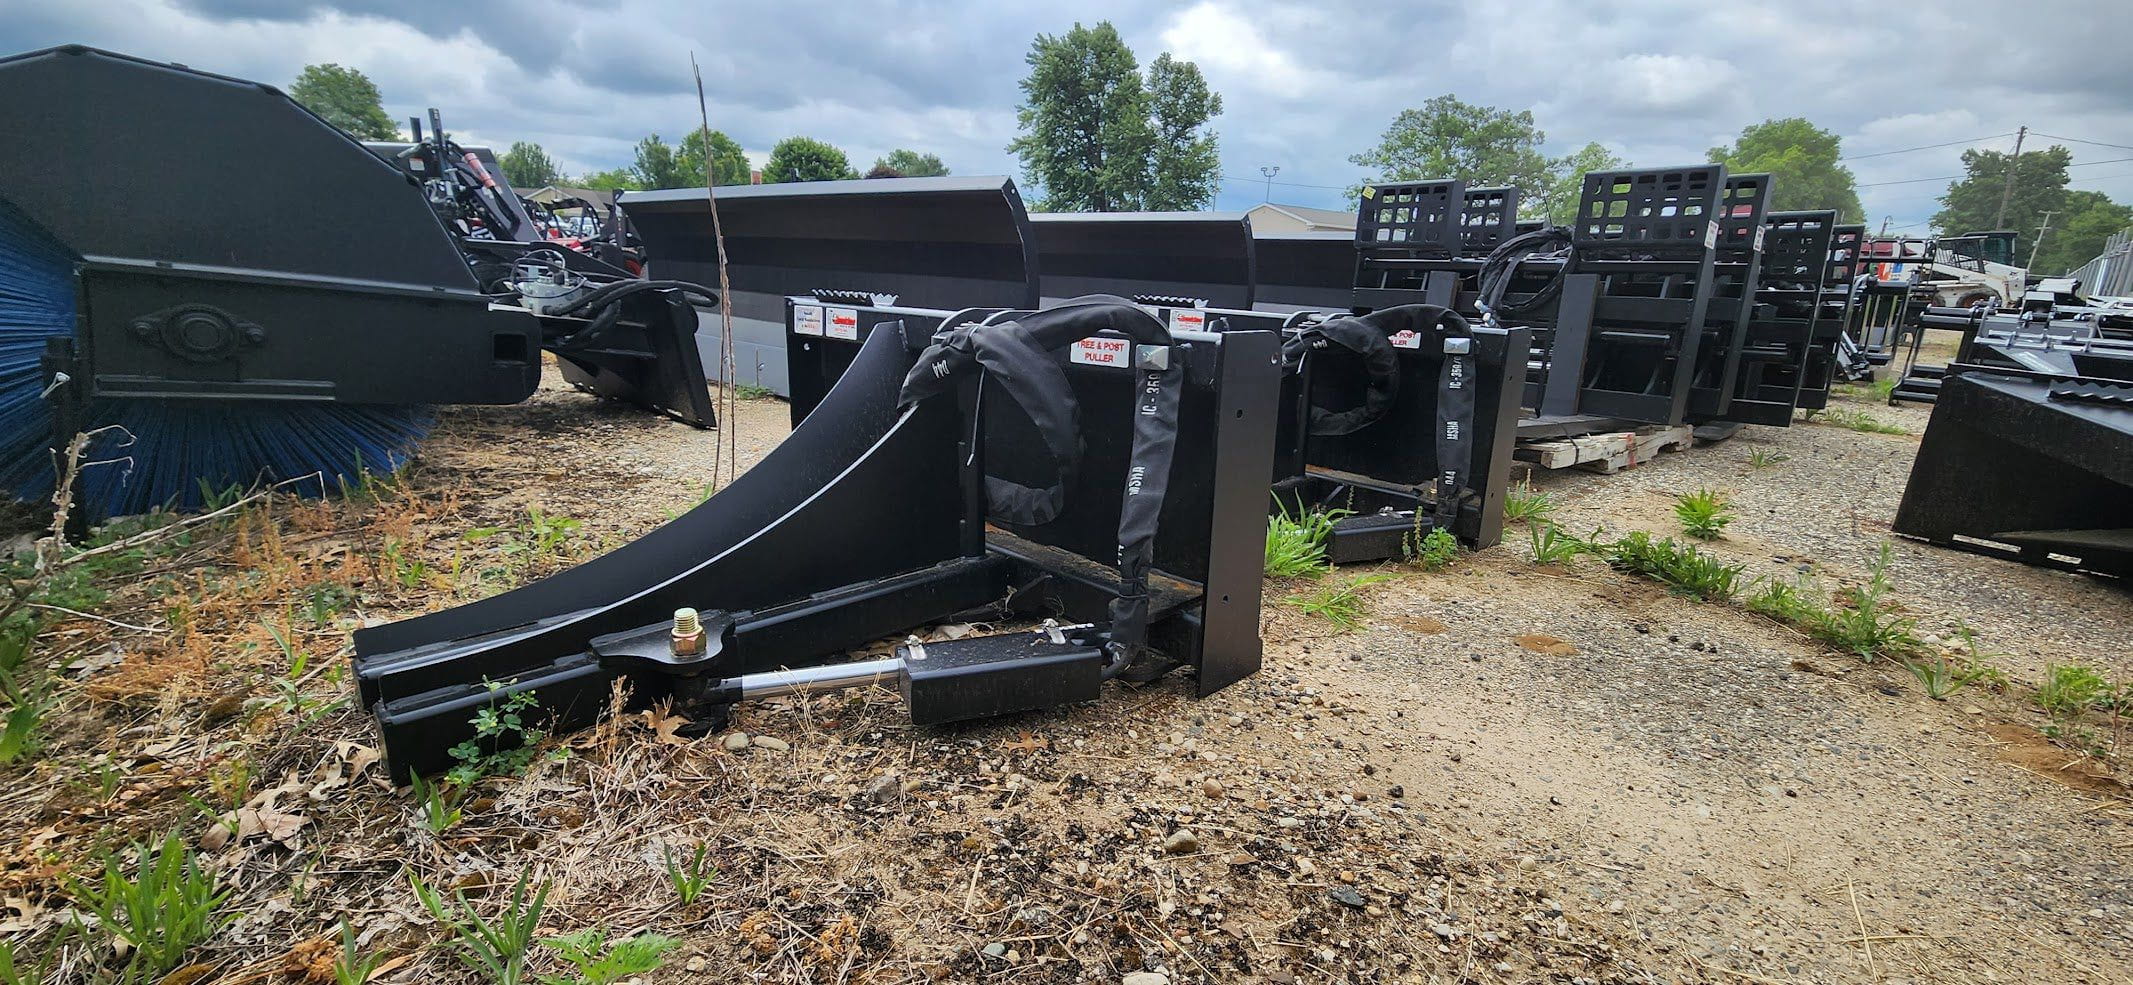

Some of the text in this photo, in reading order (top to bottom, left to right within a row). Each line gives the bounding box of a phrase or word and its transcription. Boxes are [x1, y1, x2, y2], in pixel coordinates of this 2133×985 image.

[1097, 341, 1102, 349] &
[1104, 341, 1124, 352] POST
[1085, 352, 1114, 363] PULLER
[1447, 421, 1459, 440] MSHA
[1129, 466, 1145, 496] MSHA
